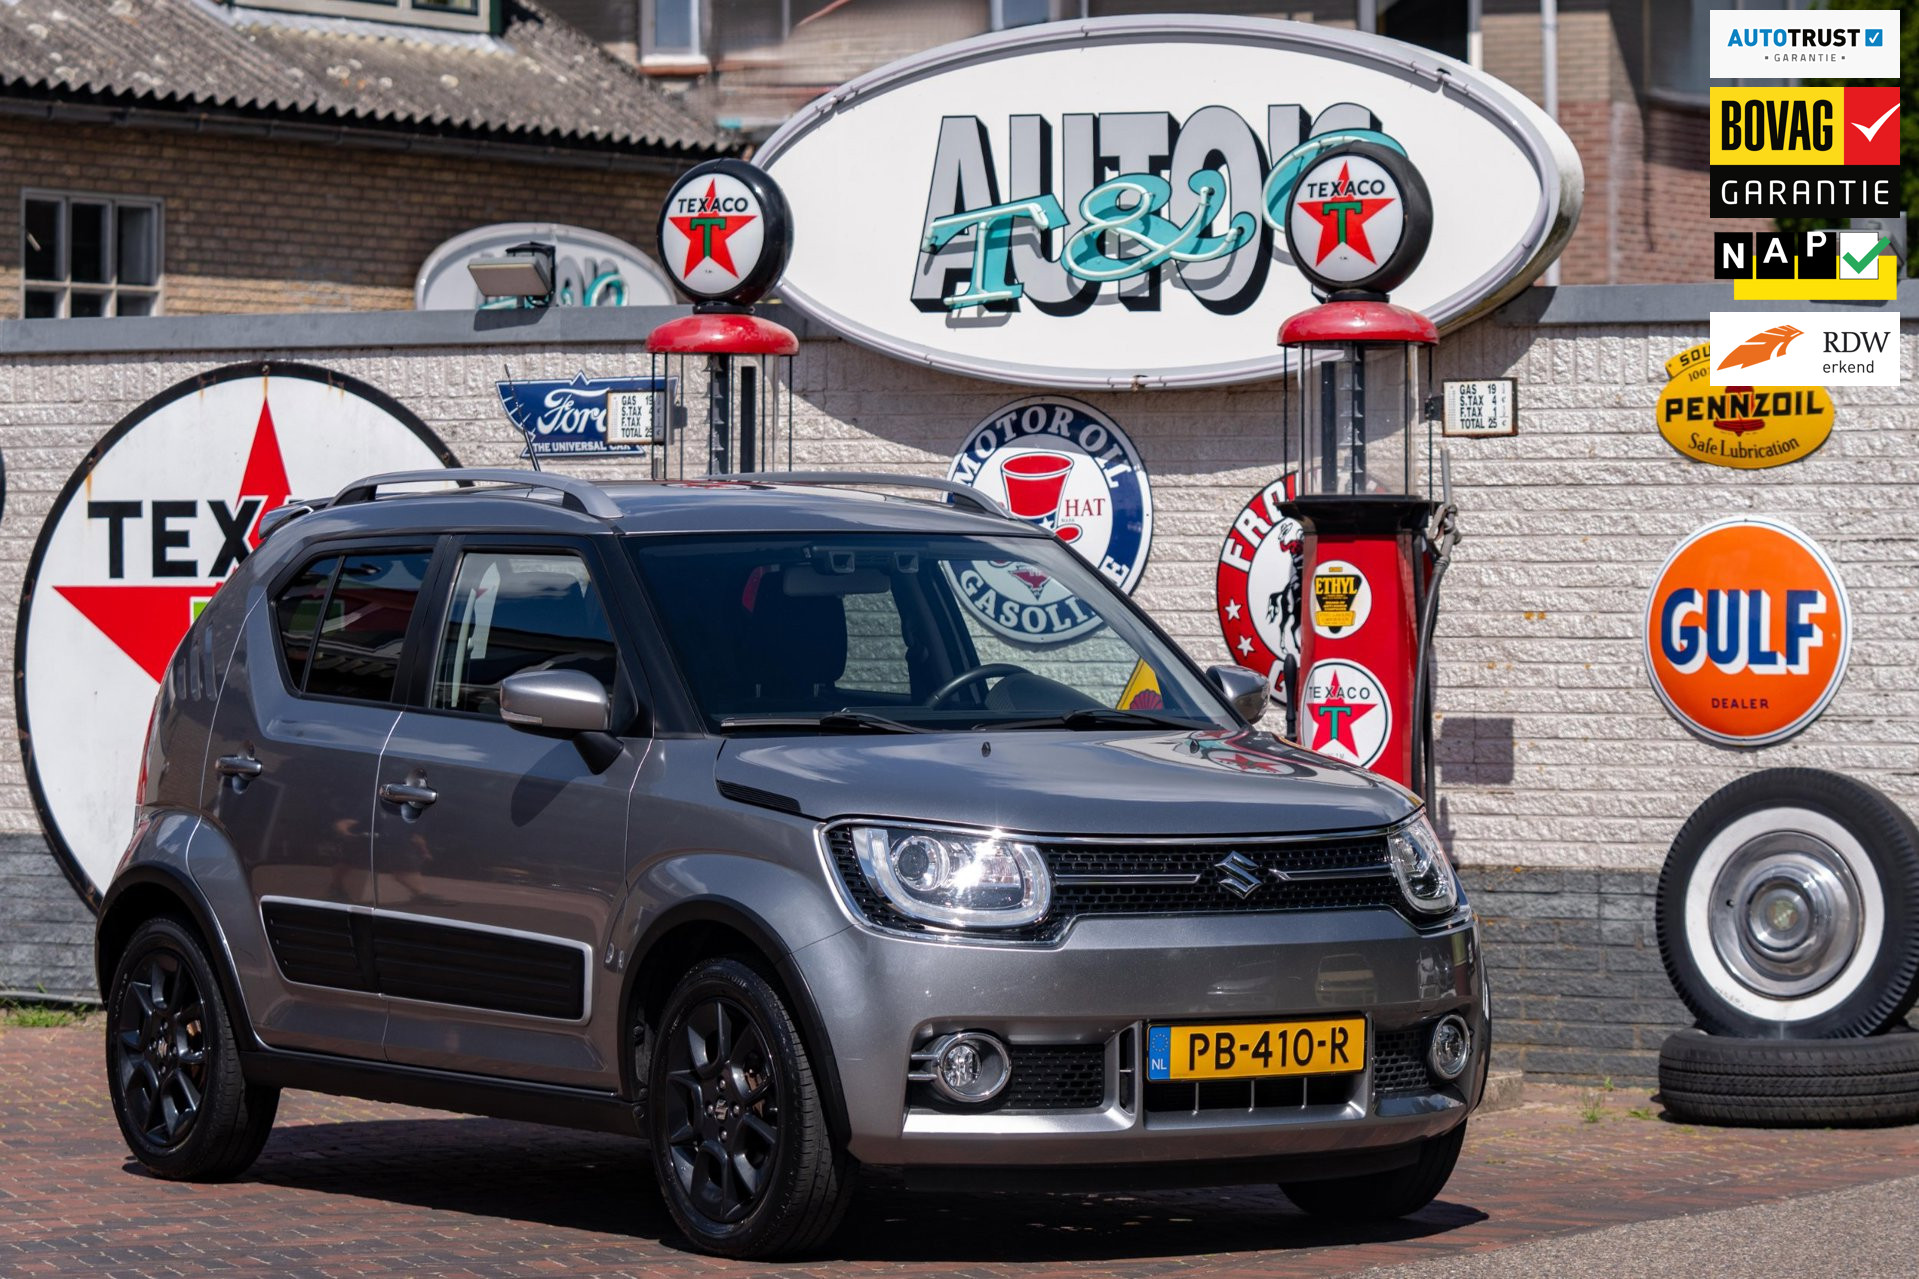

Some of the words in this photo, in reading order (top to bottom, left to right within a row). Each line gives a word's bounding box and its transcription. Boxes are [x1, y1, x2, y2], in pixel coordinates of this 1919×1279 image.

[1307, 180, 1385, 198] TEXACO
[678, 197, 748, 213] TEXACO
[1688, 367, 1710, 382] 100
[1460, 384, 1477, 395] GAS
[1487, 383, 1497, 394] 19
[622, 395, 636, 406] GAS
[1460, 395, 1484, 406] S.TAX
[1491, 395, 1497, 405] 4
[1665, 391, 1824, 422] PENNZOIL
[621, 406, 642, 416] S.TAX
[1460, 406, 1483, 417] F.TAX
[621, 417, 641, 426] F.TAX
[1460, 418, 1485, 429] TOTAL
[1488, 418, 1497, 429] 25
[621, 427, 642, 438] TOTAL
[533, 442, 552, 451] THE
[554, 441, 605, 451] UNIVERSAL
[952, 405, 1075, 487] MOTOR
[1079, 423, 1131, 488] OIL
[1688, 433, 1718, 455] Safe
[1720, 437, 1800, 459] Lubrication
[1065, 498, 1106, 517] HAT
[88, 500, 303, 579] TEX
[1315, 577, 1358, 595] ETHYL
[959, 555, 1131, 634] GASOLIE
[1661, 588, 1827, 675] GULF
[1309, 686, 1370, 700] TEXACO
[1712, 698, 1769, 709] DEALER
[1189, 1026, 1349, 1071] PB-410-R
[1151, 1058, 1167, 1070] NL
